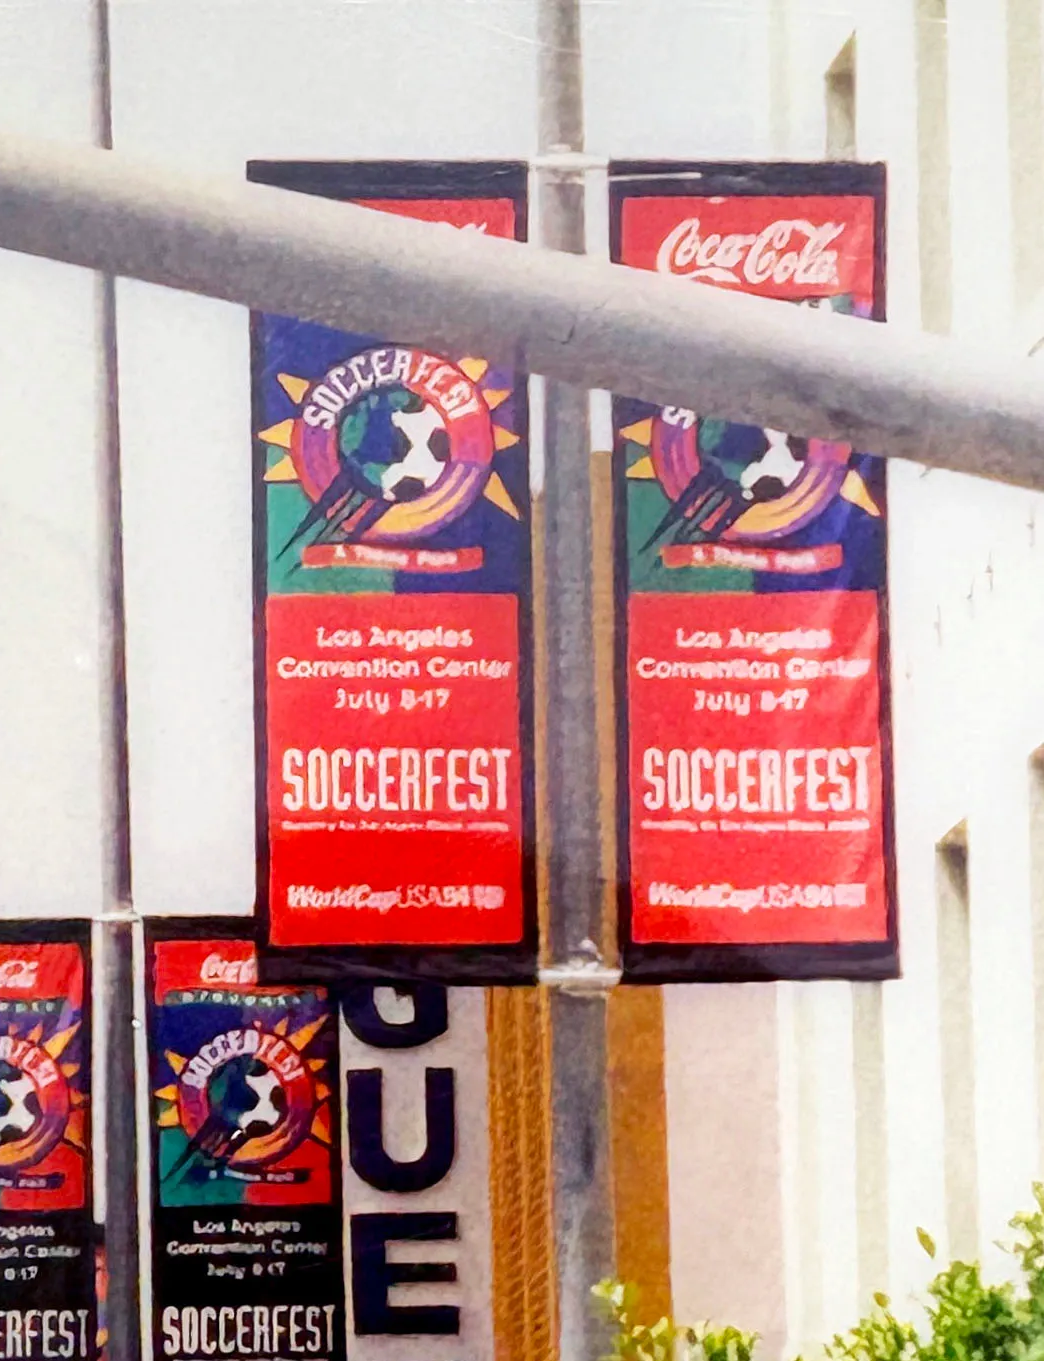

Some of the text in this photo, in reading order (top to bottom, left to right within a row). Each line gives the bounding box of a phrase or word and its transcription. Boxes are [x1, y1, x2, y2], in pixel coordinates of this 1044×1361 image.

[303, 349, 480, 430] SOCCERFEST
[316, 626, 473, 651] Los Angeles
[676, 627, 832, 655] Los Angeles
[276, 656, 513, 679] Convention Center
[636, 656, 873, 680] Convention Center
[333, 688, 390, 715] July
[693, 688, 750, 716] July
[282, 747, 512, 812] SOCCERFEST
[643, 746, 873, 813] SOCCERFEST
[162, 1304, 335, 1356] SOCCERFEST
